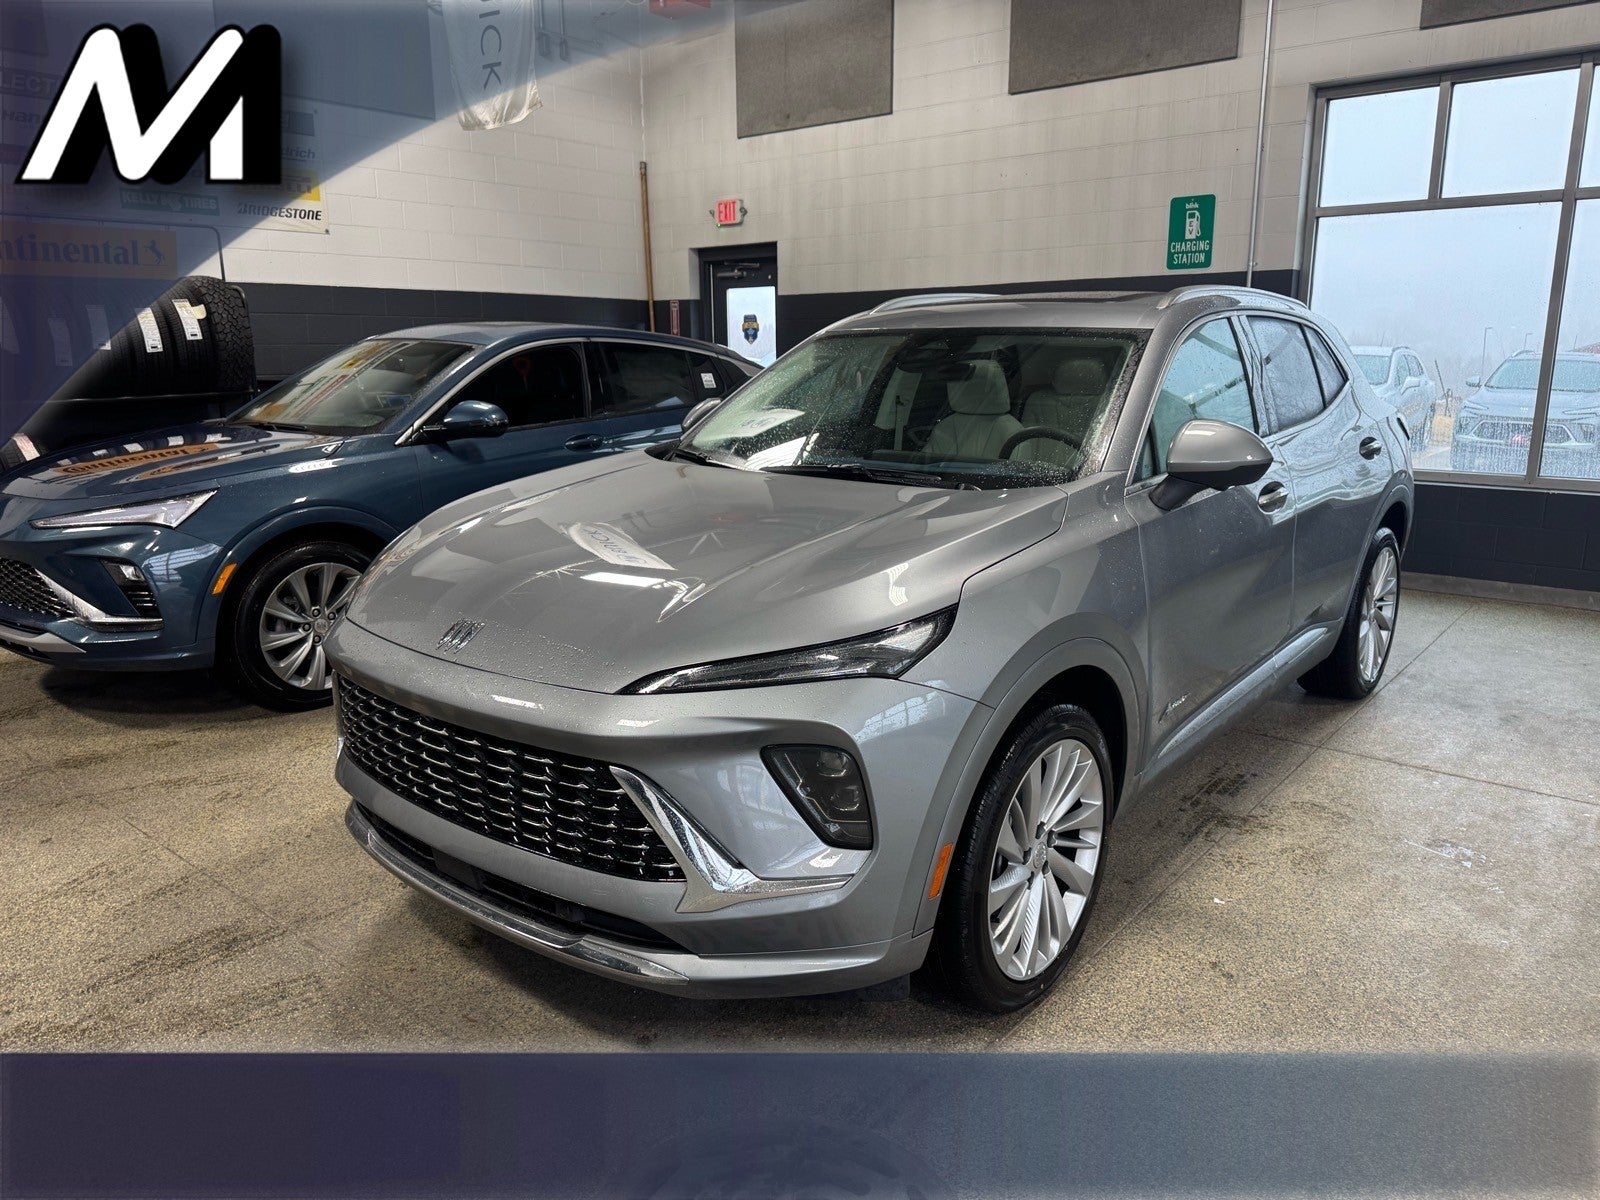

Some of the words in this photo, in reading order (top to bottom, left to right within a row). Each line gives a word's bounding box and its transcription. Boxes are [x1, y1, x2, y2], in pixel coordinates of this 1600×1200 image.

[479, 0, 503, 91] ICK
[182, 196, 218, 210] TIRES
[718, 200, 736, 222] EXIT
[237, 202, 323, 221] BRIDGESTONE
[1170, 240, 1210, 253] CHARGING
[1173, 252, 1206, 265] STATION
